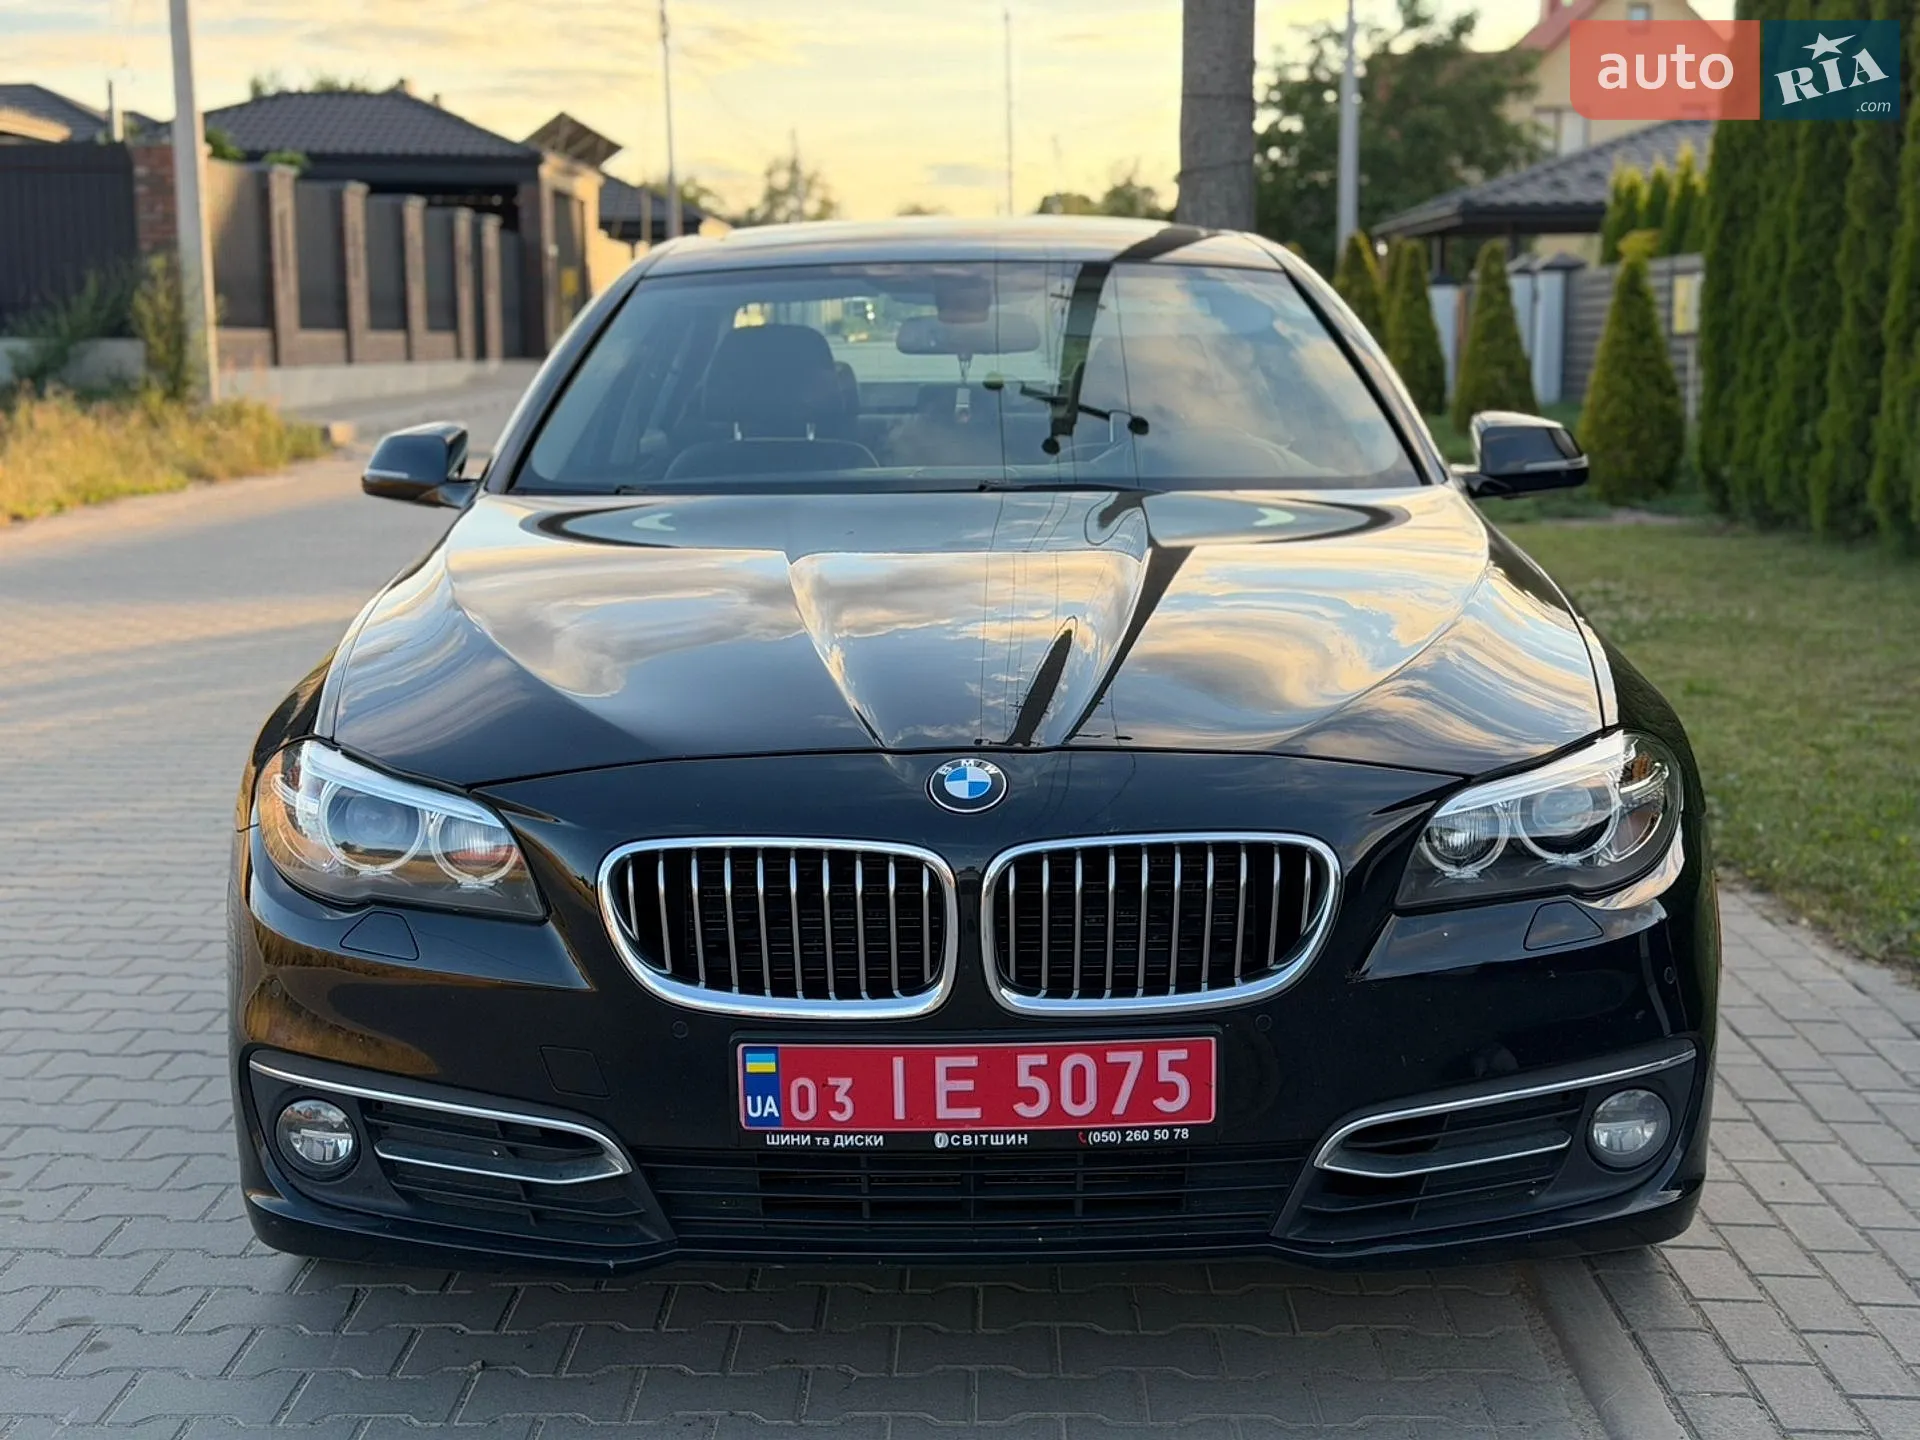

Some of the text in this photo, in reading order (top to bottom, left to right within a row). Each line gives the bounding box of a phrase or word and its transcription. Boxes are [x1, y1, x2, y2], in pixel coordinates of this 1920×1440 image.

[937, 759, 1000, 776] BMW
[790, 1048, 1191, 1122] 03 IE 5075
[746, 1095, 780, 1118] UA
[766, 1133, 884, 1147] ШИНИ та ДИСКИ
[950, 1133, 1028, 1146] СВІТШИН
[1087, 1128, 1189, 1144] (050) 260 50 78
